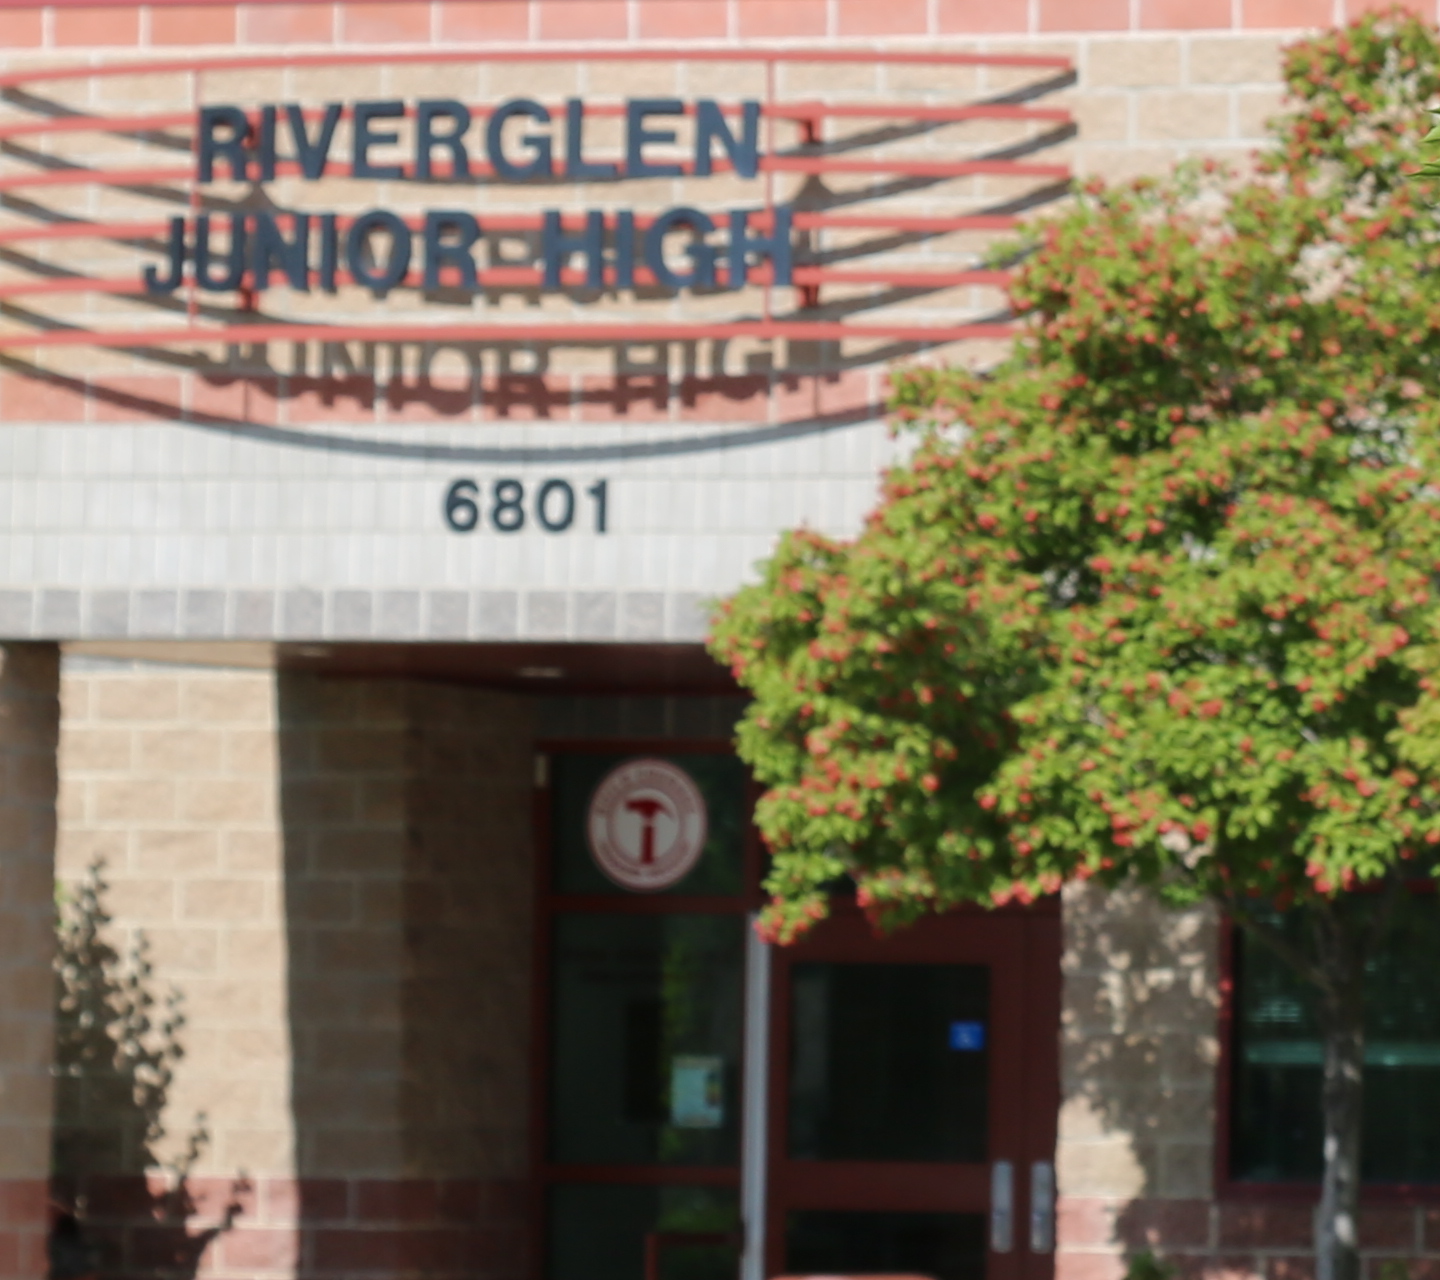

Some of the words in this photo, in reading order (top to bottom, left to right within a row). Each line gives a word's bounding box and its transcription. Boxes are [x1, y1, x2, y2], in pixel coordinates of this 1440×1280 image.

[198, 98, 762, 181] RIVERGLEN
[142, 210, 484, 293] JUNIOR
[541, 206, 794, 289] HIGH
[444, 478, 611, 534] 6801
